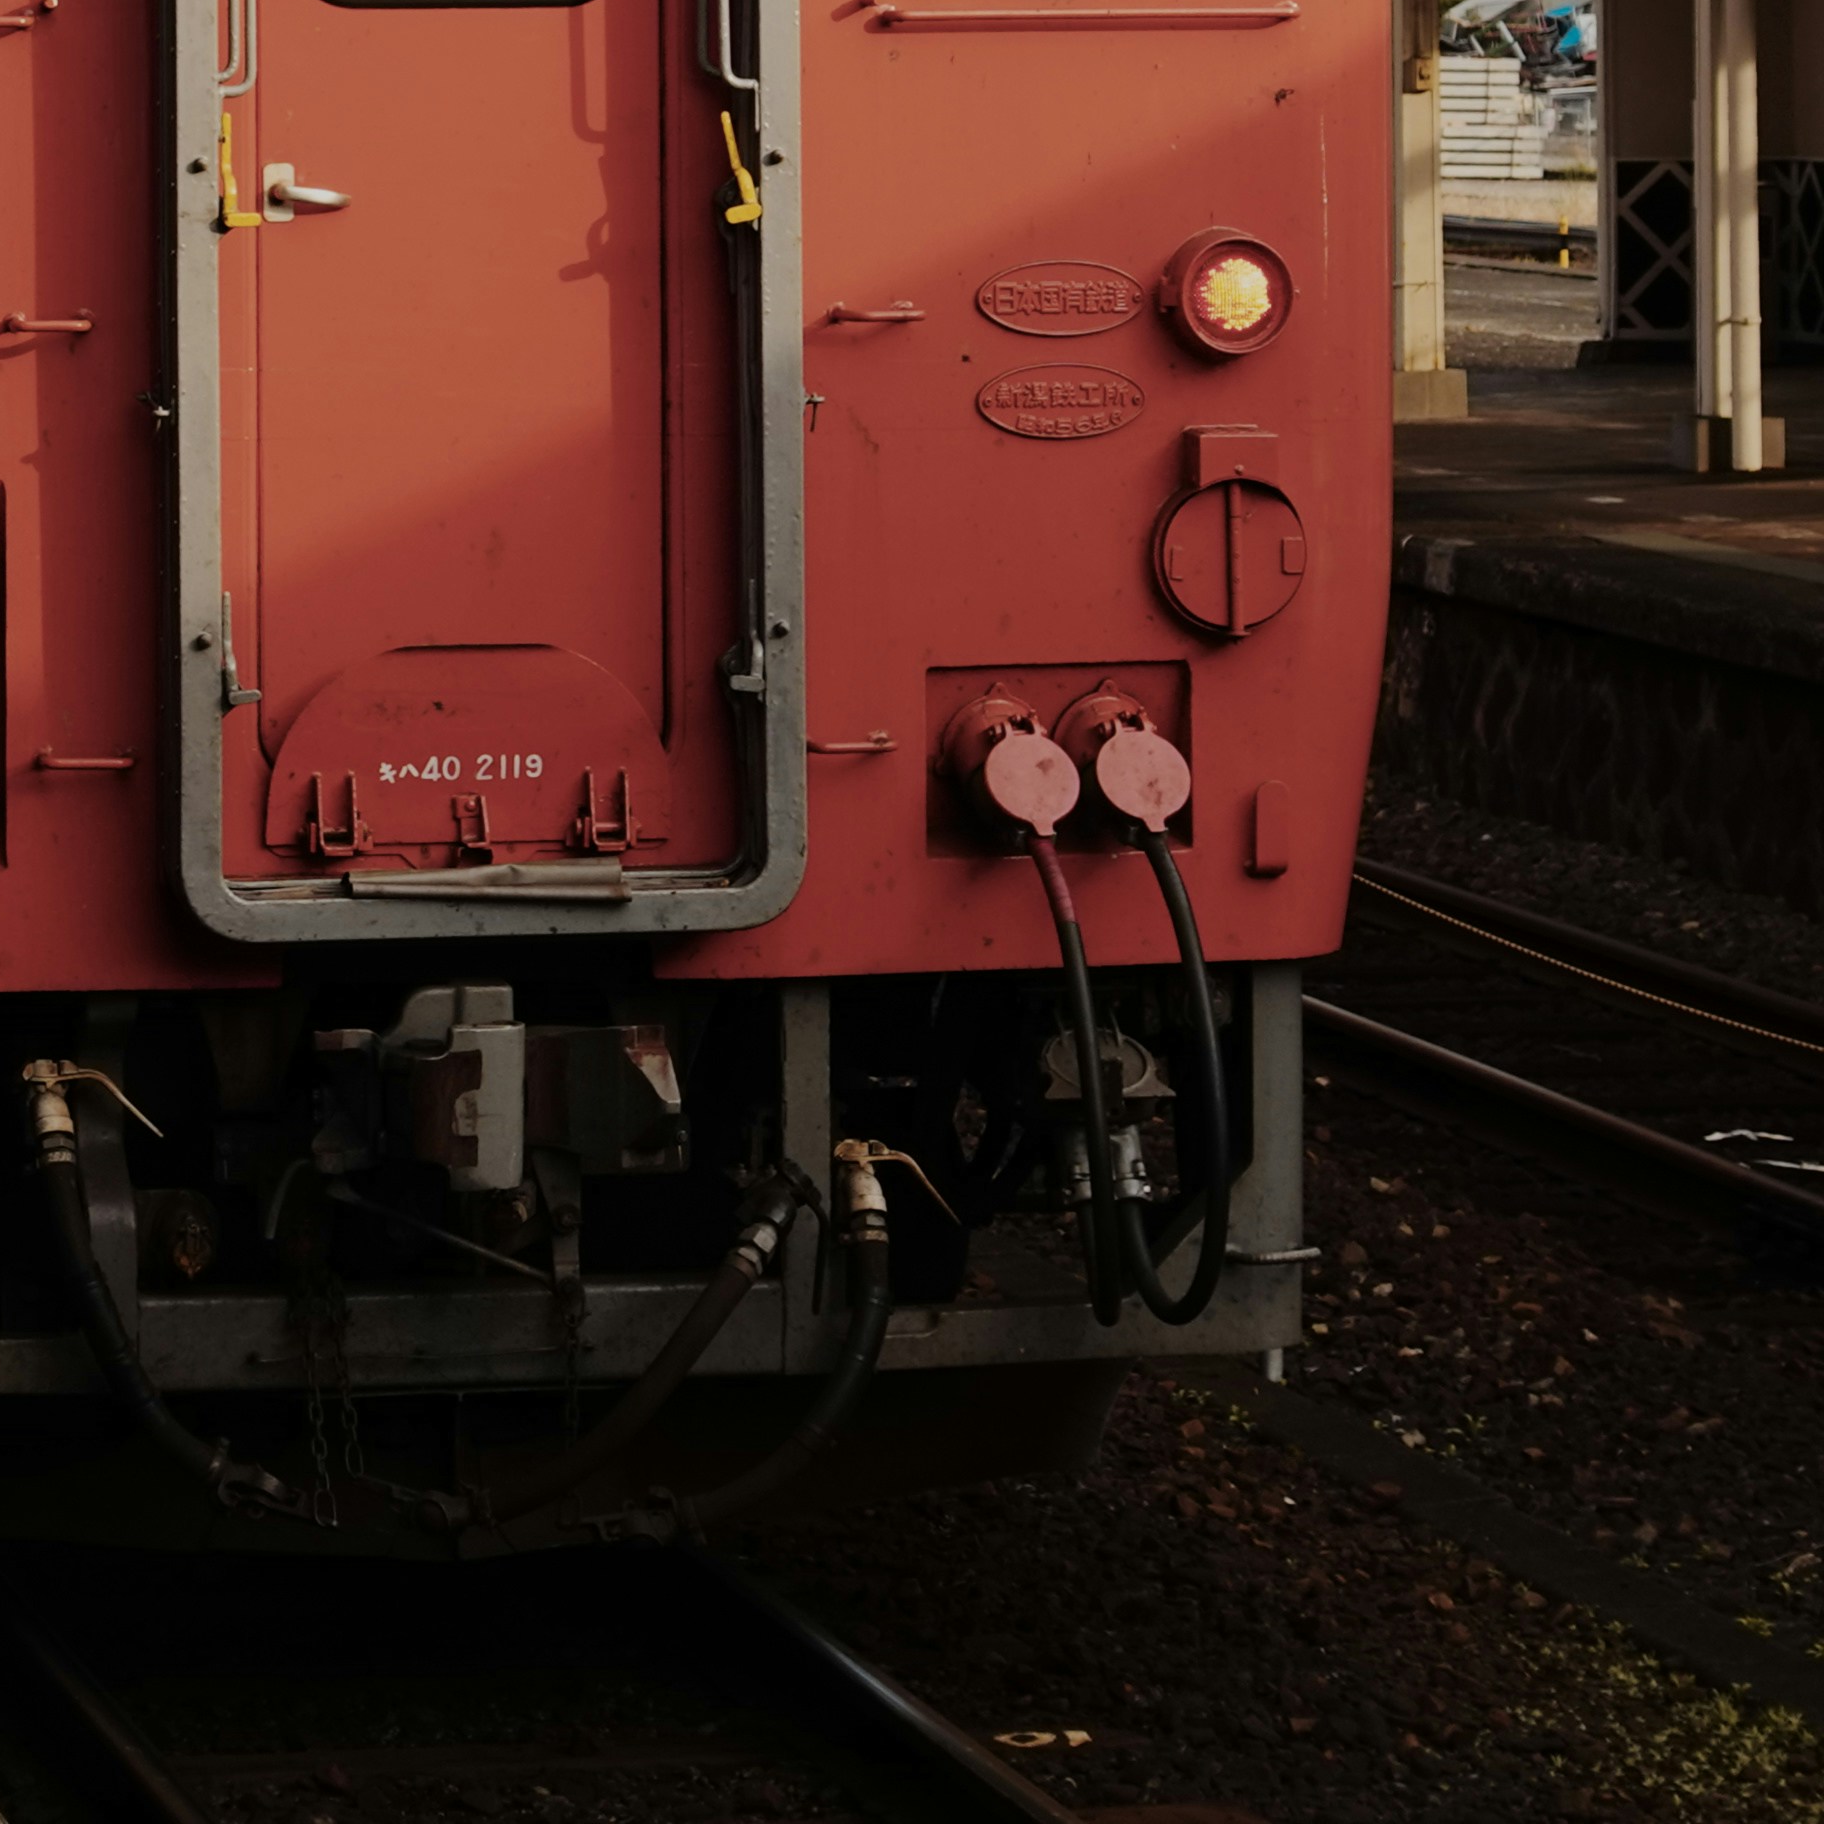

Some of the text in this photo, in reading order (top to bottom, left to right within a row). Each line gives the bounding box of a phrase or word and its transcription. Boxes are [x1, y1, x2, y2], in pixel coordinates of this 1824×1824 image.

[994, 280, 1130, 315] 日本国有鉄道
[379, 754, 543, 783] キハ40 2119
